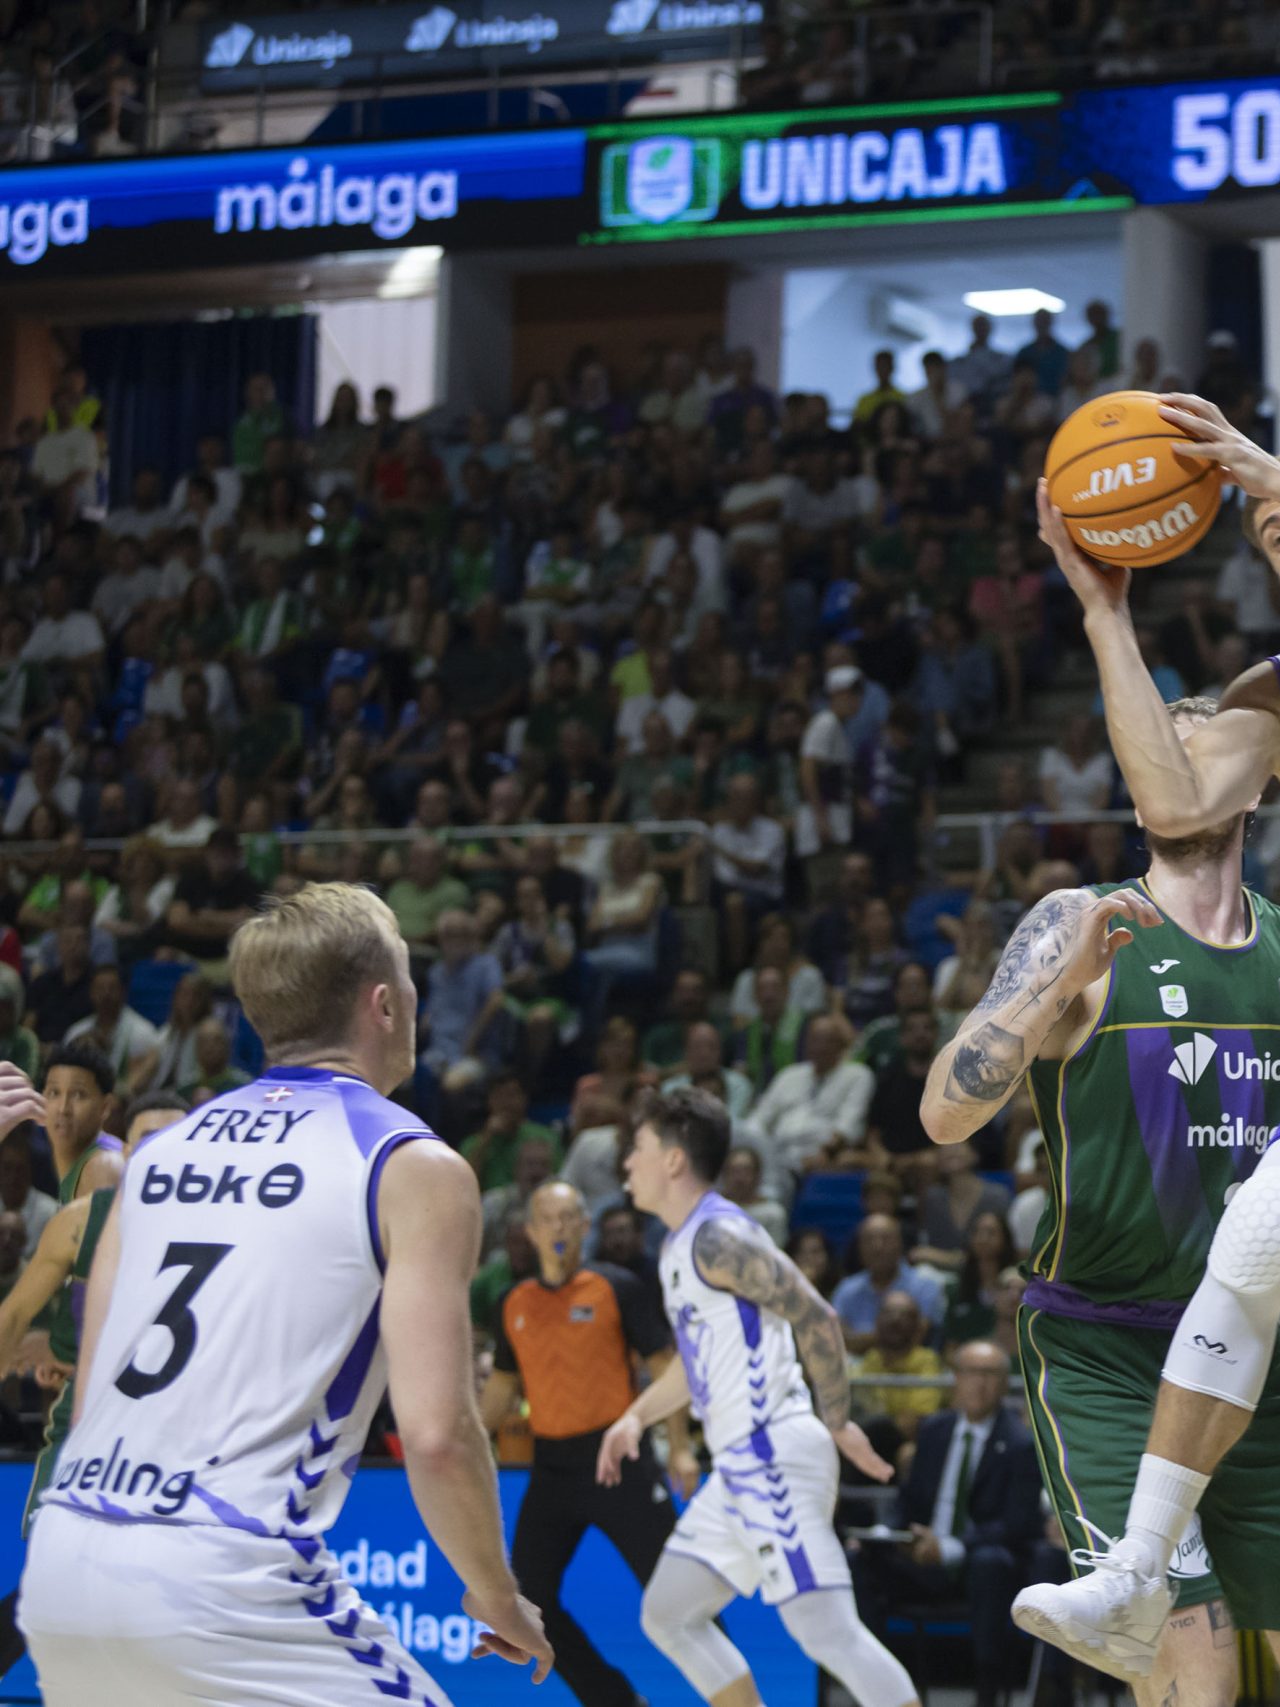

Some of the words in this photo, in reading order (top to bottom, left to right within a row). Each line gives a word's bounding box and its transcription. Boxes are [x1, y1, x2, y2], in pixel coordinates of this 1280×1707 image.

[740, 122, 1007, 211] UNICAJA
[1078, 501, 1200, 549] Wilson
[185, 1108, 315, 1145] FREY
[140, 1162, 254, 1205] bbk
[114, 1241, 236, 1400] 3
[326, 1537, 428, 1588] dad
